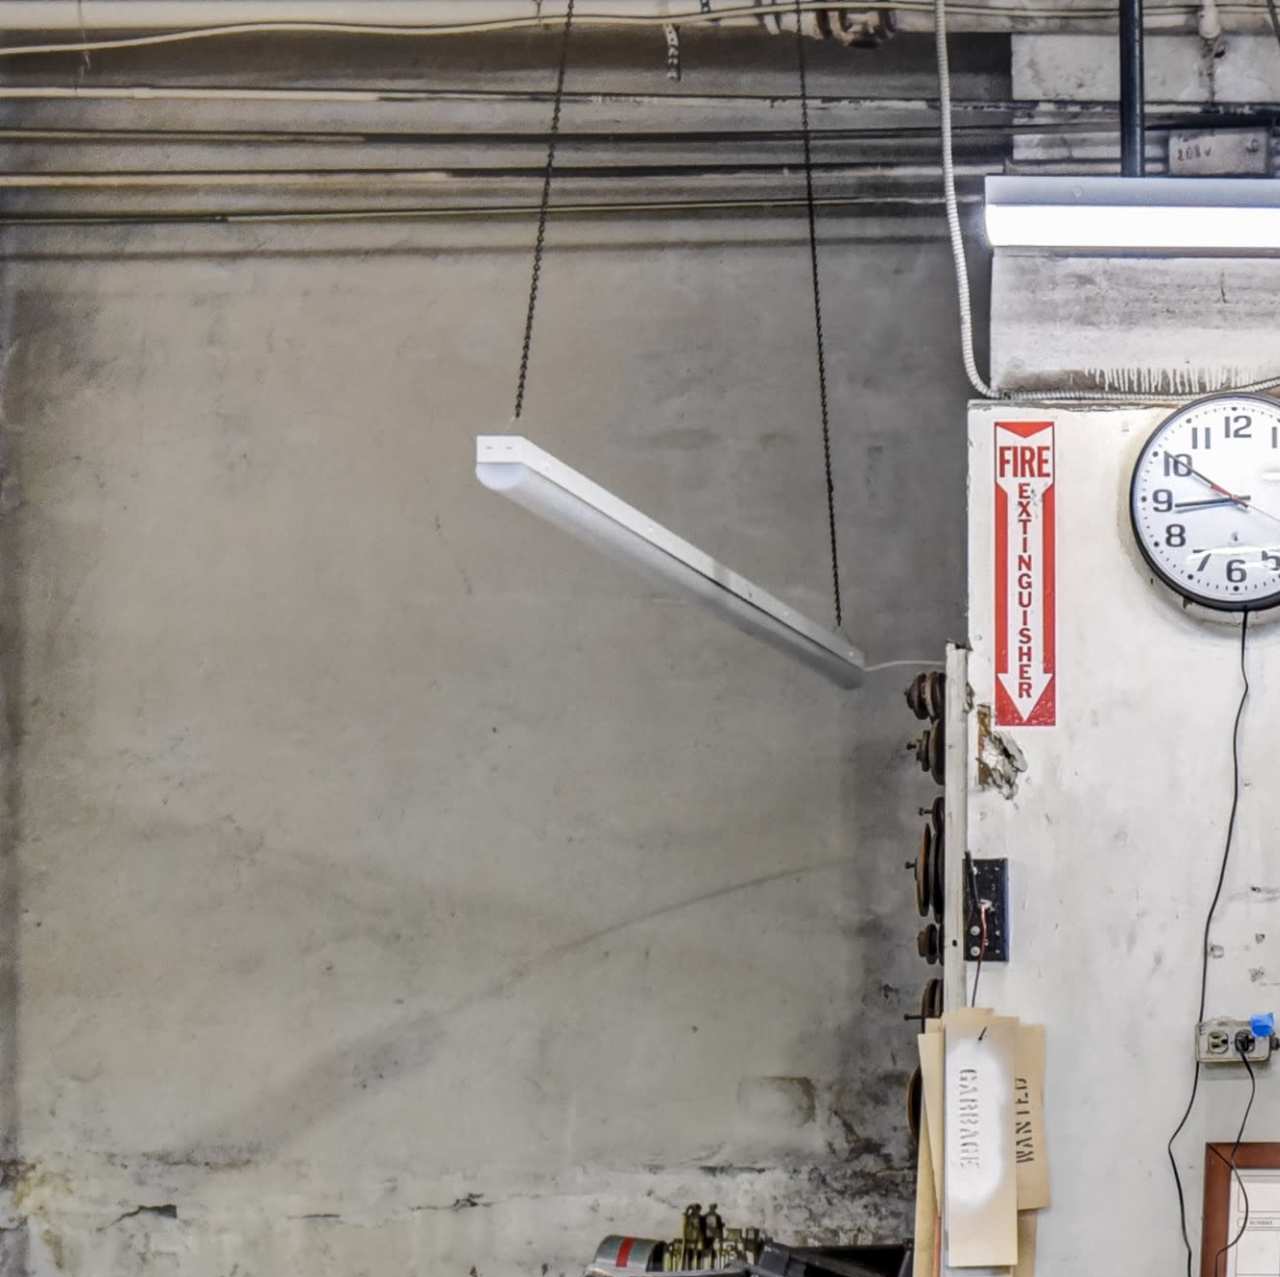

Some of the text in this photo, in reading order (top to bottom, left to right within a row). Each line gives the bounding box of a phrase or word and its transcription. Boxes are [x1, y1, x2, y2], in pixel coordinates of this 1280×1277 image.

[1192, 426, 1211, 450] 11
[1224, 415, 1252, 439] 12
[1271, 426, 1278, 449] 1
[999, 446, 1051, 478] FIRE
[1163, 452, 1193, 477] 10
[1152, 489, 1173, 513] 9
[1165, 524, 1187, 548] 8
[1192, 549, 1212, 572] 7
[1226, 559, 1247, 583] 6
[1017, 482, 1033, 699] EXTINGUISHER
